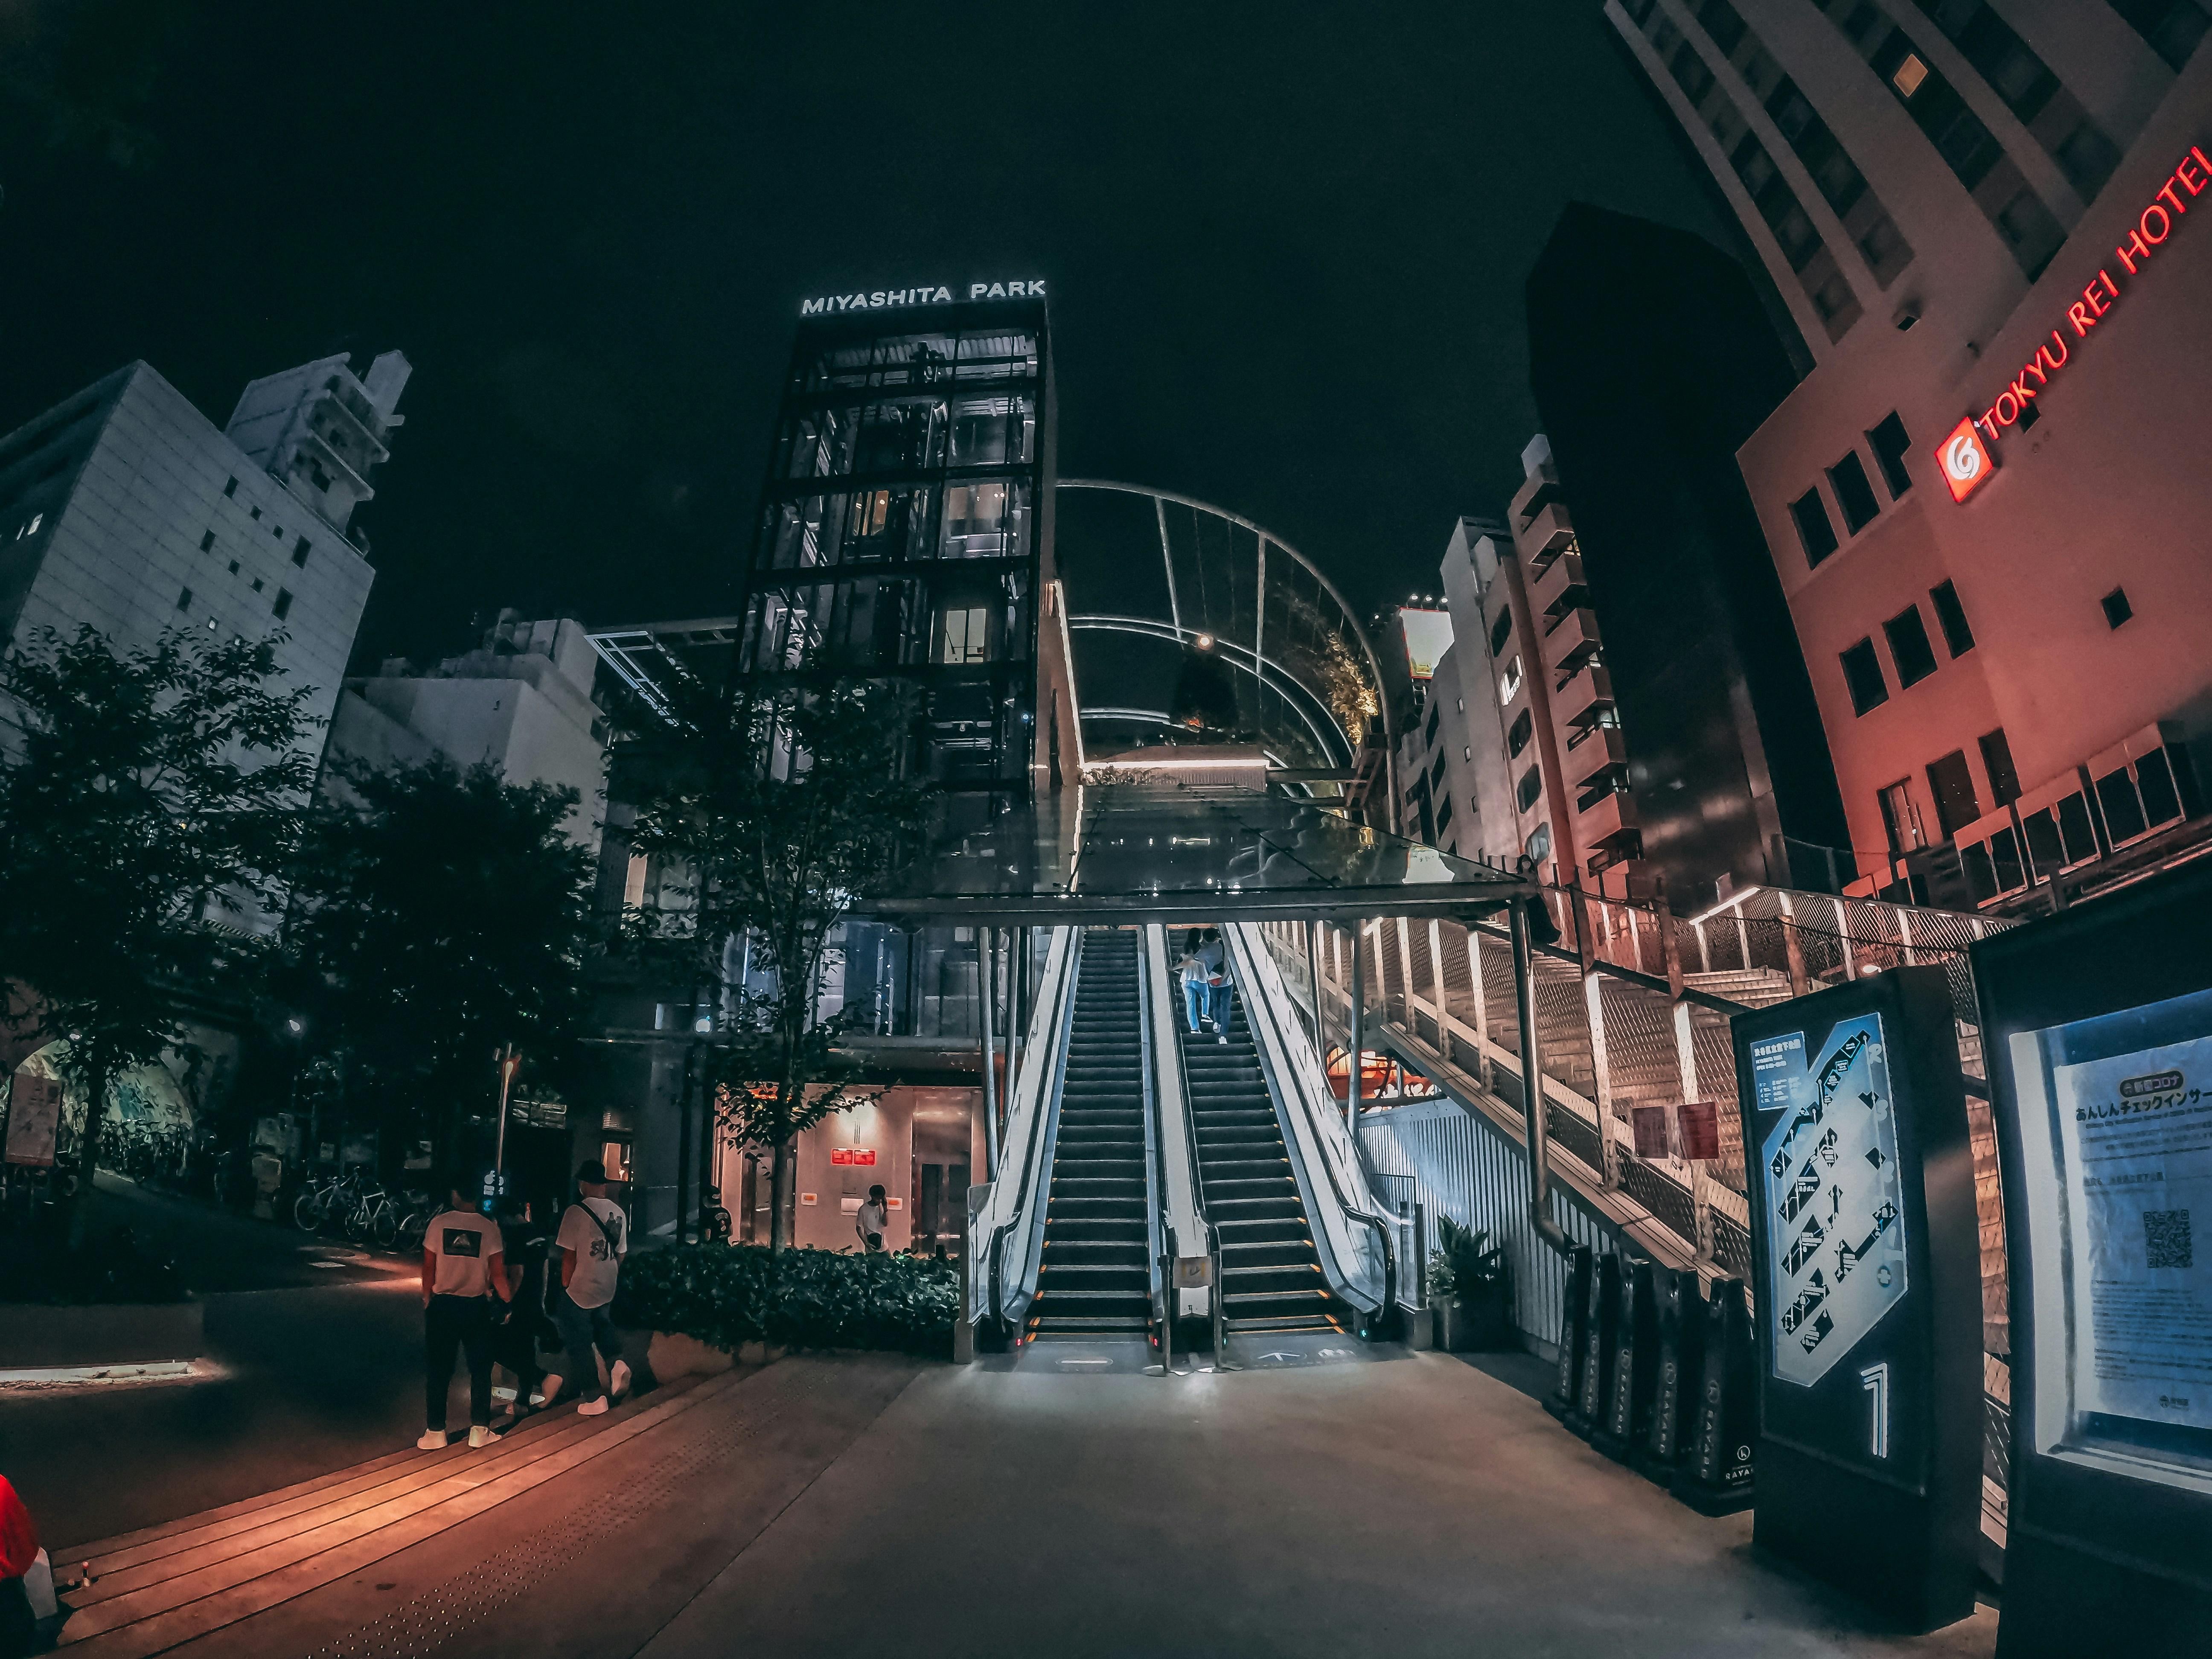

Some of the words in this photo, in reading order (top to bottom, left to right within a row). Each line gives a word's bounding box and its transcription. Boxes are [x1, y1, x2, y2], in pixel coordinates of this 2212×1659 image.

[802, 286, 951, 314] MIYASHITA
[971, 280, 1046, 299] PARK
[1979, 330, 2068, 439] TOKYU
[2067, 269, 2119, 337] REI
[1861, 1363, 1888, 1458] 1
